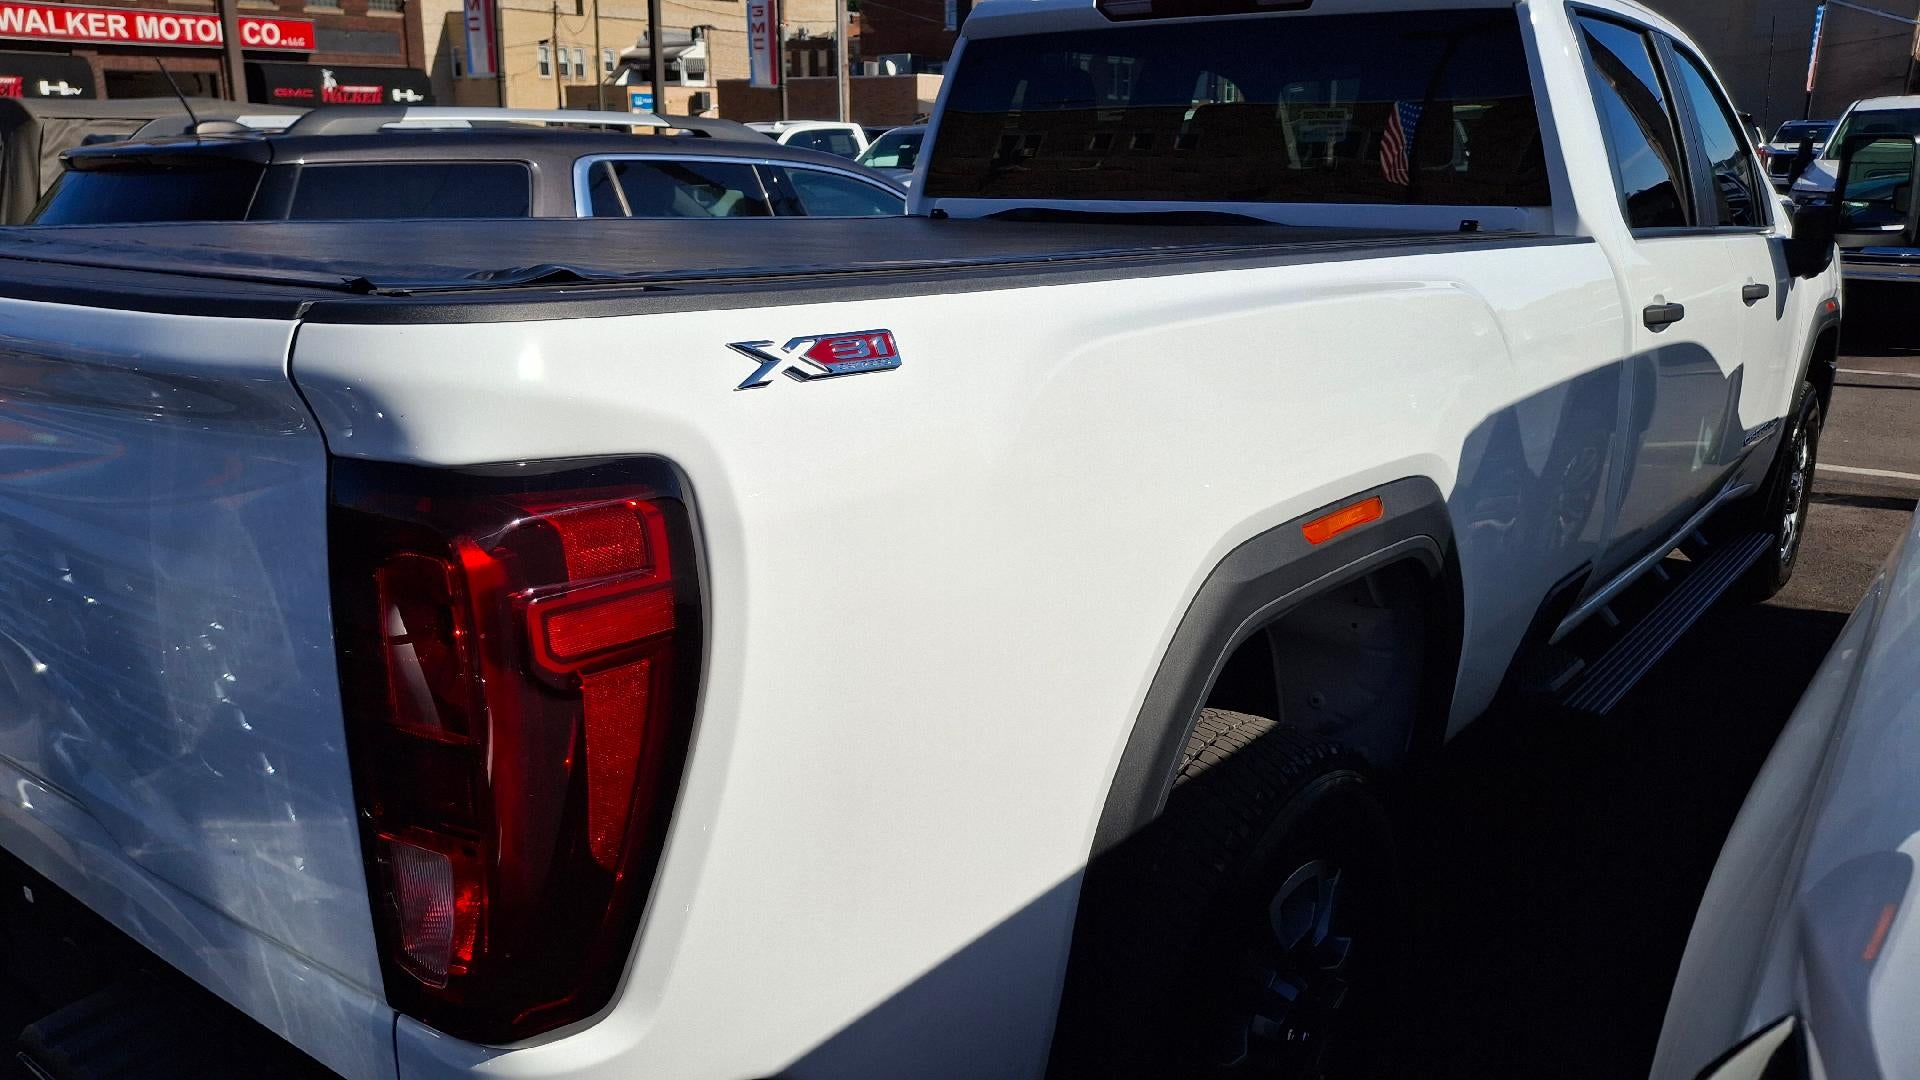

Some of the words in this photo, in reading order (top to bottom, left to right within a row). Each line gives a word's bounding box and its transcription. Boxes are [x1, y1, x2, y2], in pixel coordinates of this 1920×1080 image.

[0, 7, 129, 38] WALKER
[243, 21, 288, 46] CO.
[751, 5, 766, 50] GMC
[274, 88, 315, 99] GMC
